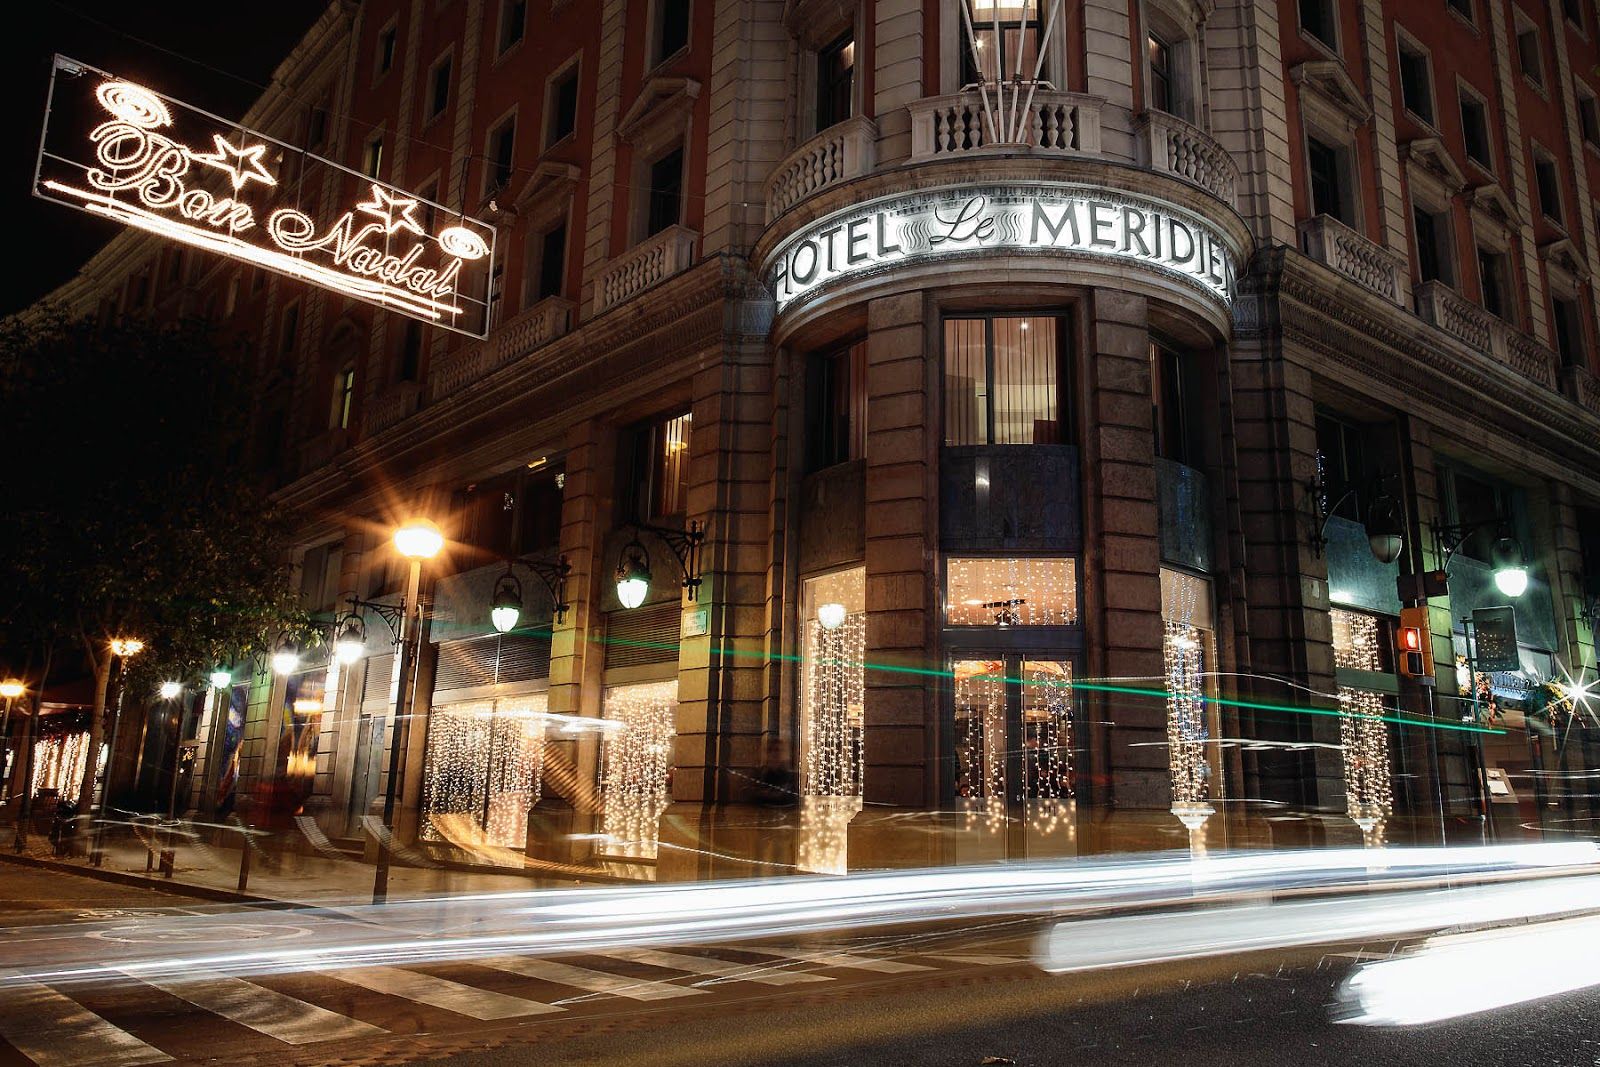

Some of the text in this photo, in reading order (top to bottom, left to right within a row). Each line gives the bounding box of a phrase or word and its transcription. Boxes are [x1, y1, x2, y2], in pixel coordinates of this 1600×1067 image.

[88, 120, 463, 298] Bon Nadal
[775, 213, 899, 303] HOTEL
[929, 195, 994, 243] Le
